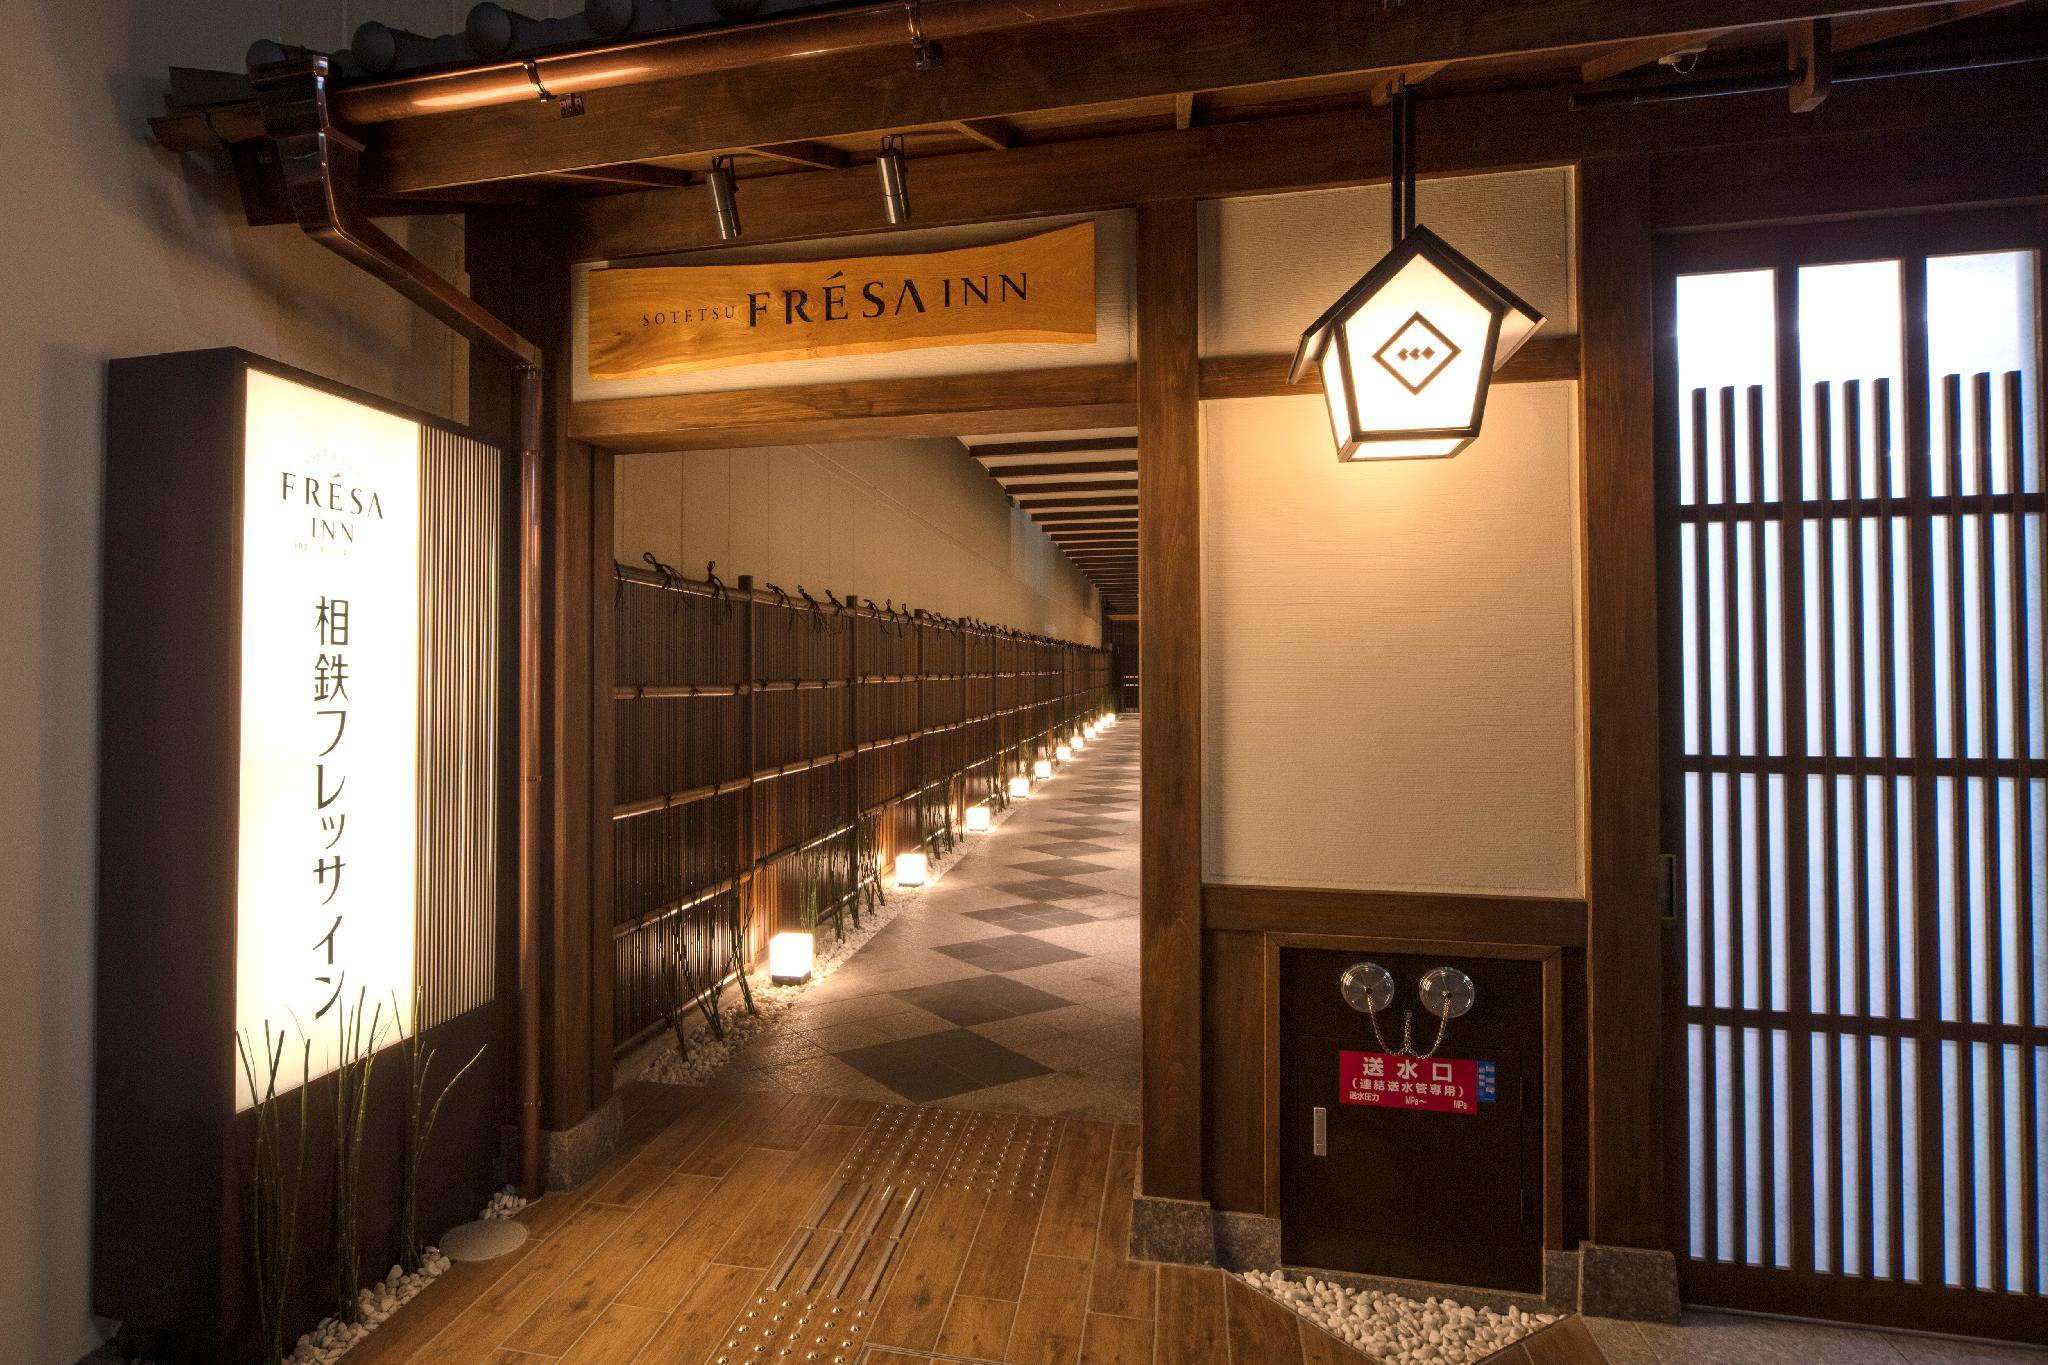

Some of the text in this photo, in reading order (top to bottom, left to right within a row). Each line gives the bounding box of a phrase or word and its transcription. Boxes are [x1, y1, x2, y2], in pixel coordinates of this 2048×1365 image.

[642, 270, 1029, 328] SOTETSU FRÉSA INN
[280, 471, 384, 520] FRÉSA
[311, 516, 355, 545] INN
[312, 595, 350, 1020] 相鉄フレッサイン
[1362, 1056, 1453, 1082] 送水口
